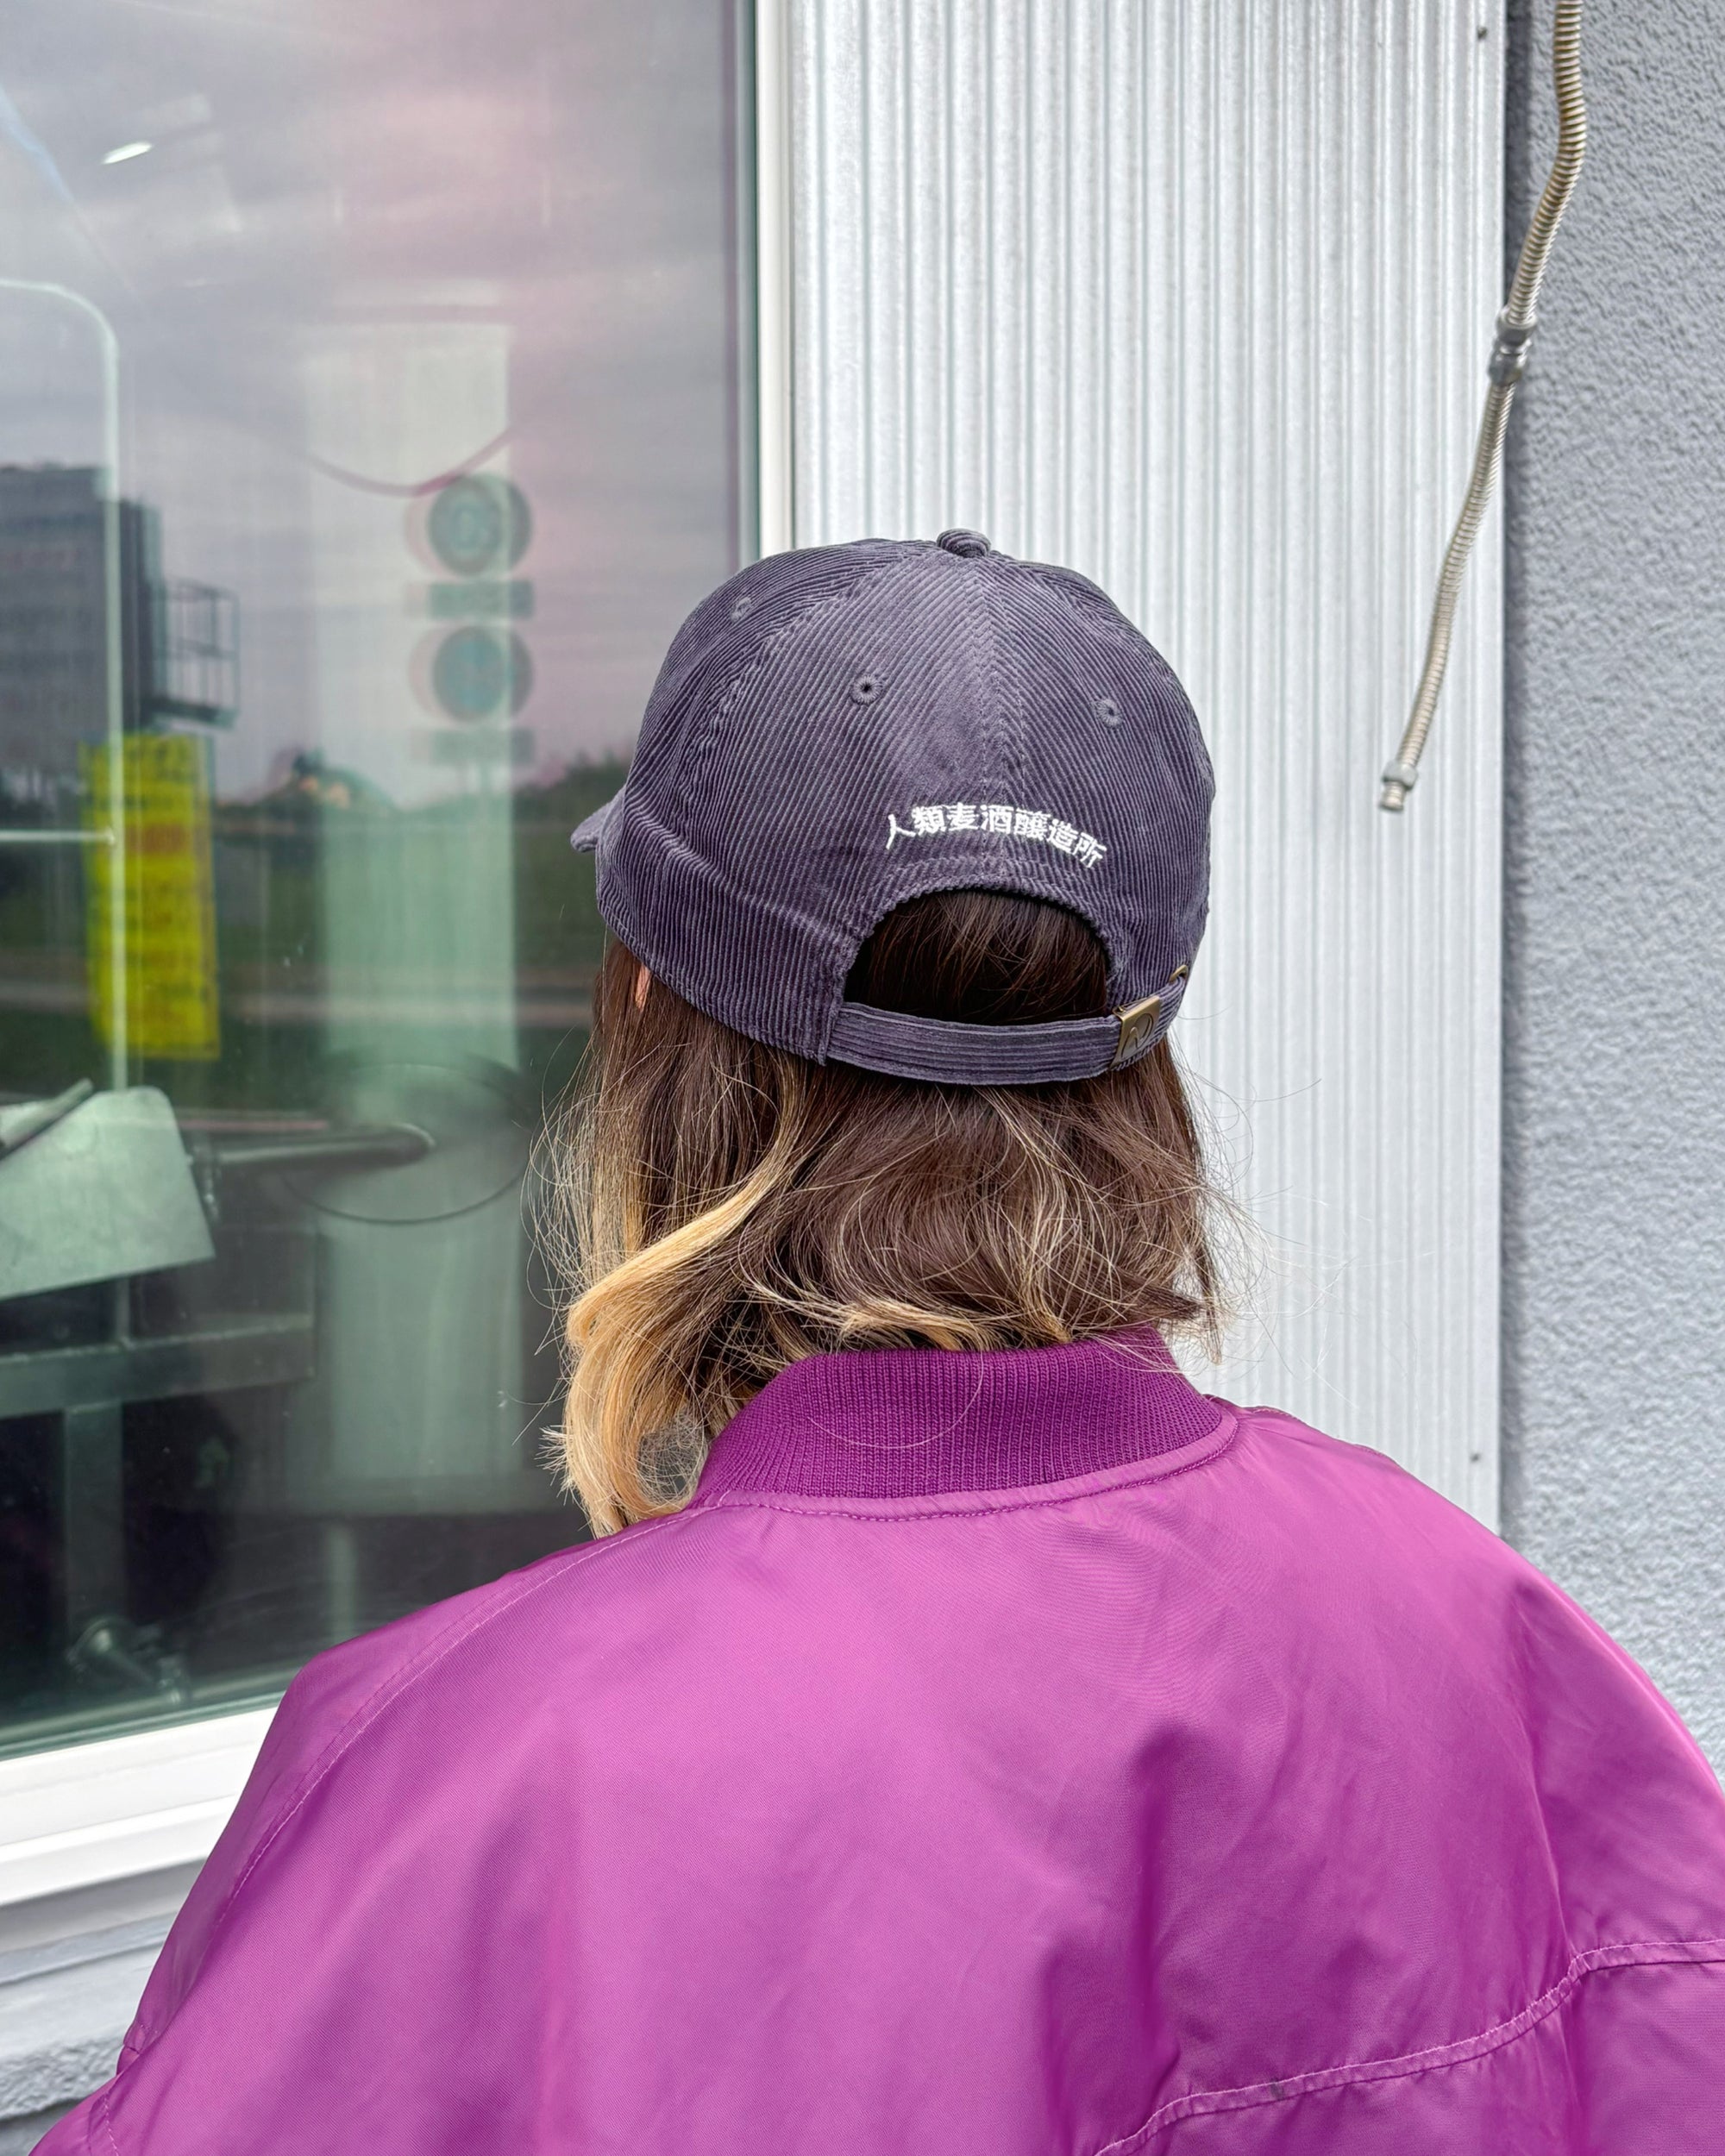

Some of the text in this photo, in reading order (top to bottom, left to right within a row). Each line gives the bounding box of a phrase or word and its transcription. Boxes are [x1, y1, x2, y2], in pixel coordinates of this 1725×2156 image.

[886, 801, 1107, 868] 人類麦酒醸造所
